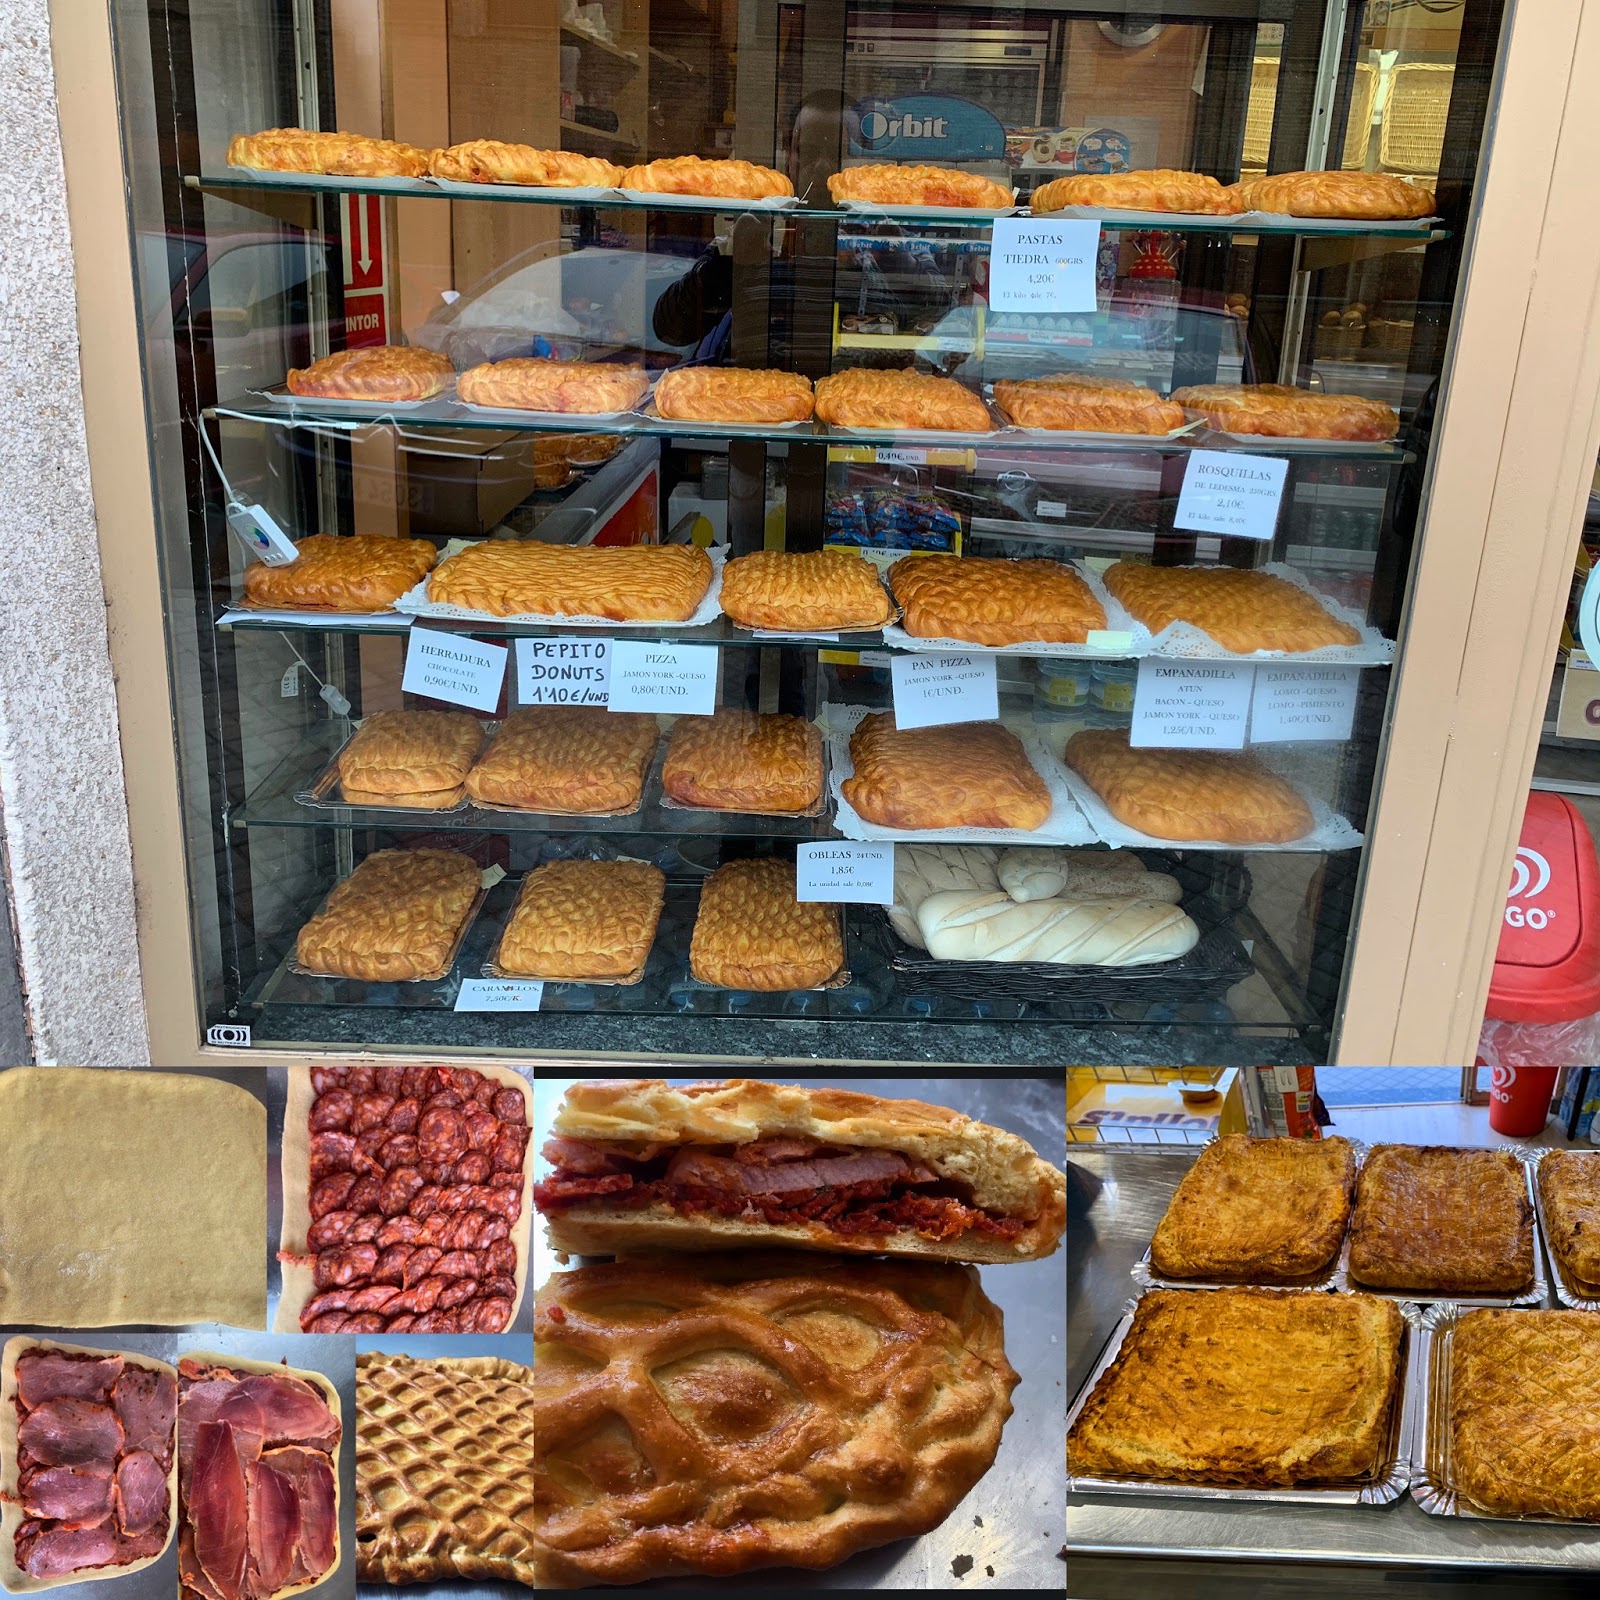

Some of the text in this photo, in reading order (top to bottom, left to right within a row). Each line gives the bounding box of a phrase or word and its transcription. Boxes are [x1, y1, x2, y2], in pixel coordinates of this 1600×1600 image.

[860, 111, 949, 140] Orbit
[1017, 234, 1063, 245] PASTAS
[1003, 254, 1049, 264] TIEDRA
[1027, 274, 1055, 284] 4,20€
[1013, 291, 1027, 299] kilo
[1197, 464, 1272, 481] ROSQUILLAS
[1208, 483, 1246, 493] LEDESMA
[533, 642, 606, 659] PEPITO
[420, 644, 491, 668] HERRADURA
[645, 654, 677, 664] PIZZA
[912, 657, 972, 671] PAN PIZZA
[427, 662, 476, 679] CHOCOLATE
[531, 664, 605, 682] DONUTS
[623, 671, 651, 679] JAMON
[653, 671, 675, 679] YORK
[1155, 668, 1236, 679] EMPANADILLA
[904, 676, 931, 686] JAMON
[932, 674, 953, 682] YORK
[1267, 672, 1347, 682] EMPANADILLA
[424, 674, 480, 695] 0,90€/UND.
[1177, 685, 1203, 693] ATUN
[631, 685, 689, 696] 0,80€/UND.
[923, 686, 965, 698] 1€/UND.
[1273, 687, 1300, 696] LOMO
[1155, 698, 1186, 706] BACON
[1193, 699, 1225, 707] QUESO
[1143, 711, 1175, 719] JAMON
[1176, 711, 1201, 719] YORK
[1208, 713, 1240, 721] QUESO
[808, 850, 852, 860] OBLEAS
[831, 866, 855, 875] 1,85€
